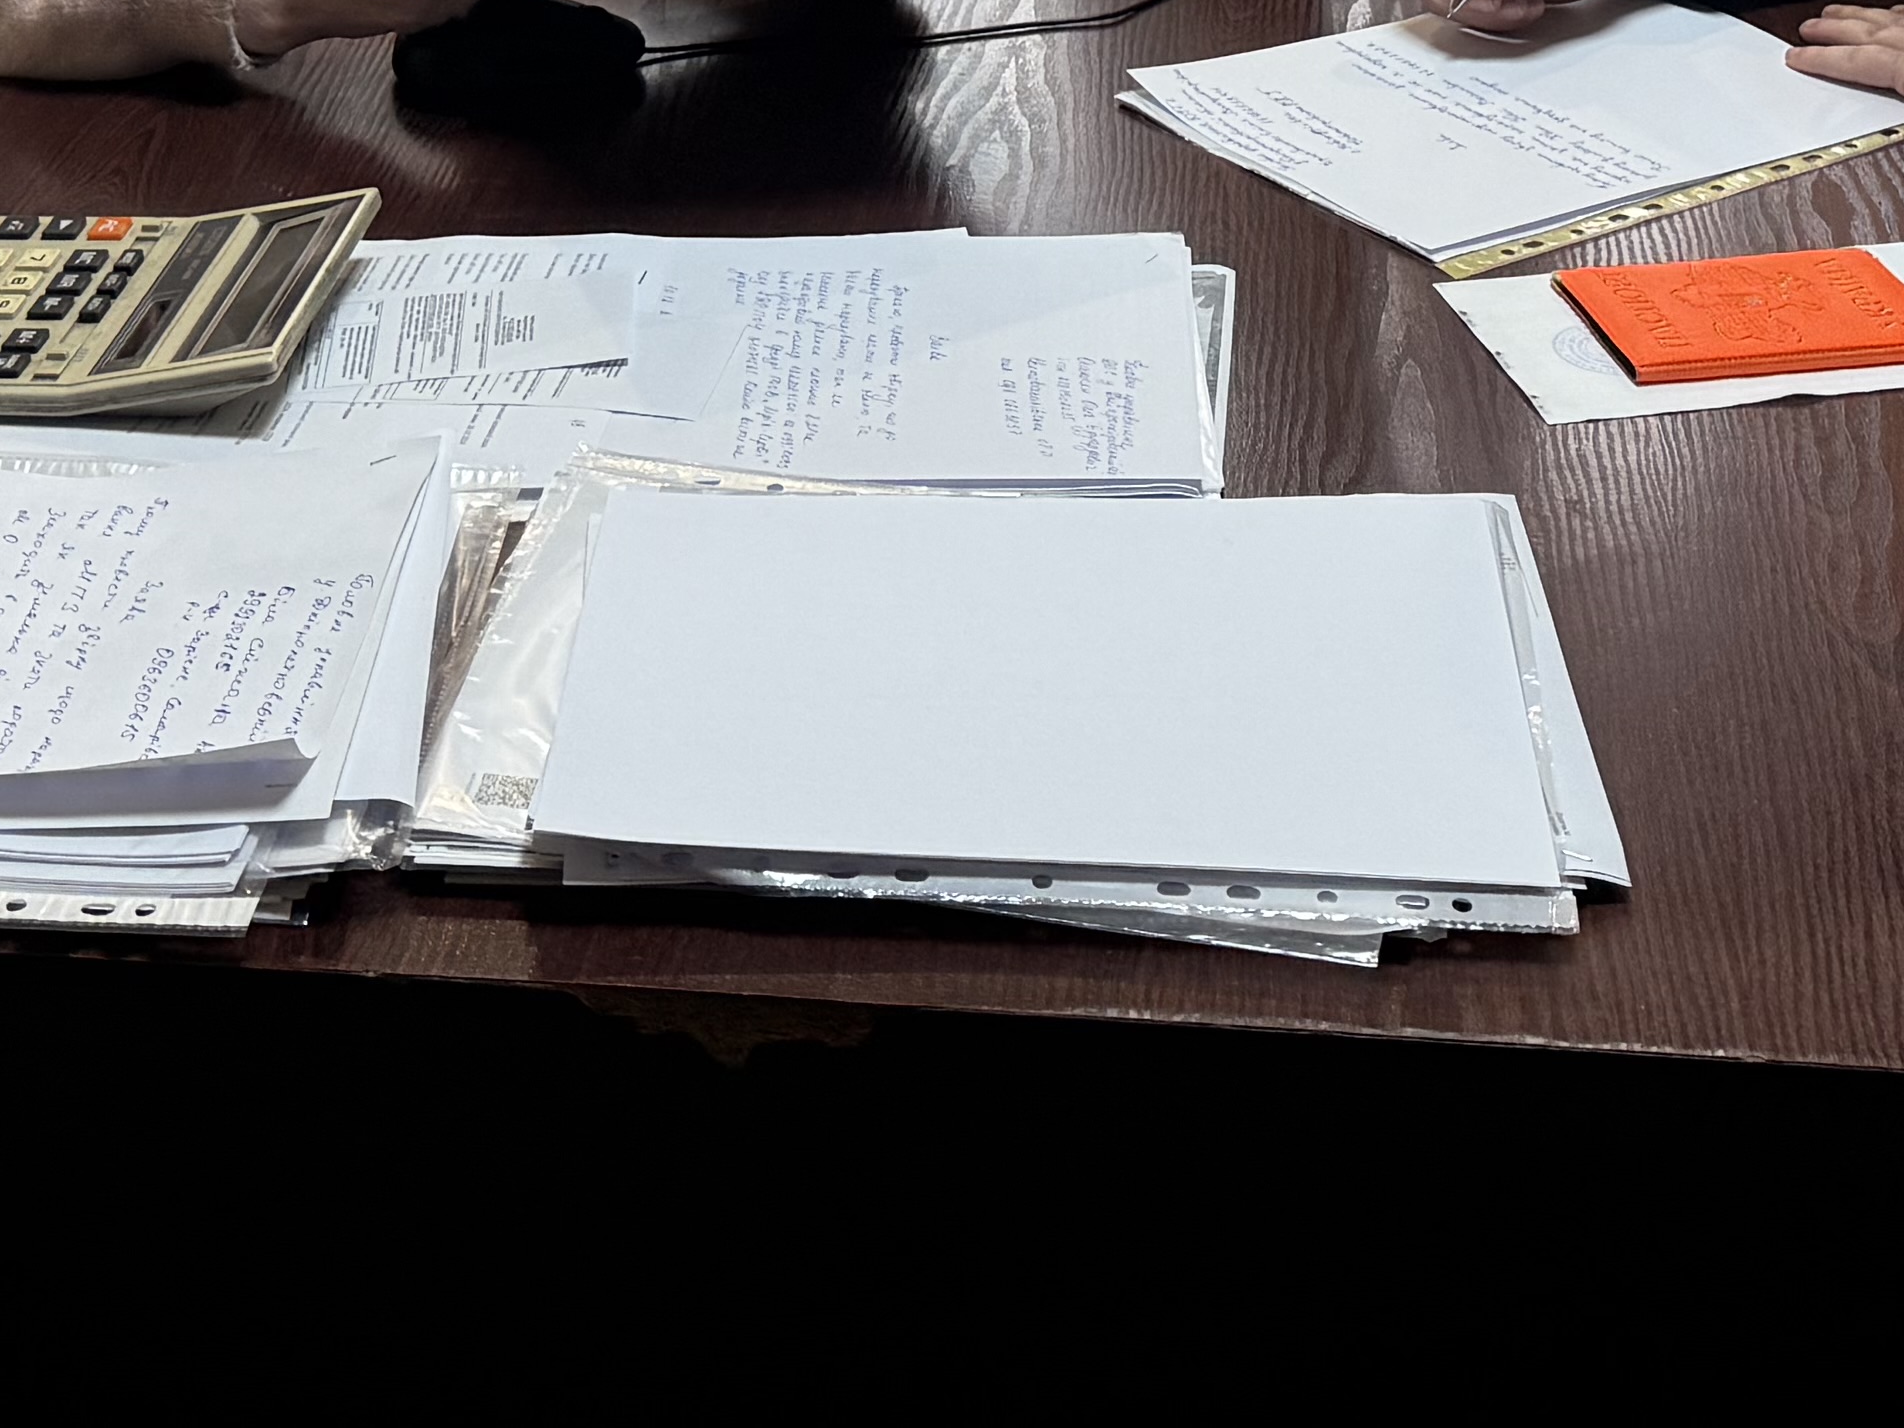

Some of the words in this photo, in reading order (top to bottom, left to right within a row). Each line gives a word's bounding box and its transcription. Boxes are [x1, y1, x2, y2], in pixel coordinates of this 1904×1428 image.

[30, 253, 46, 262] 7
[10, 277, 28, 285] 8
[260, 586, 297, 626] Біла
[47, 685, 75, 725] щодо
